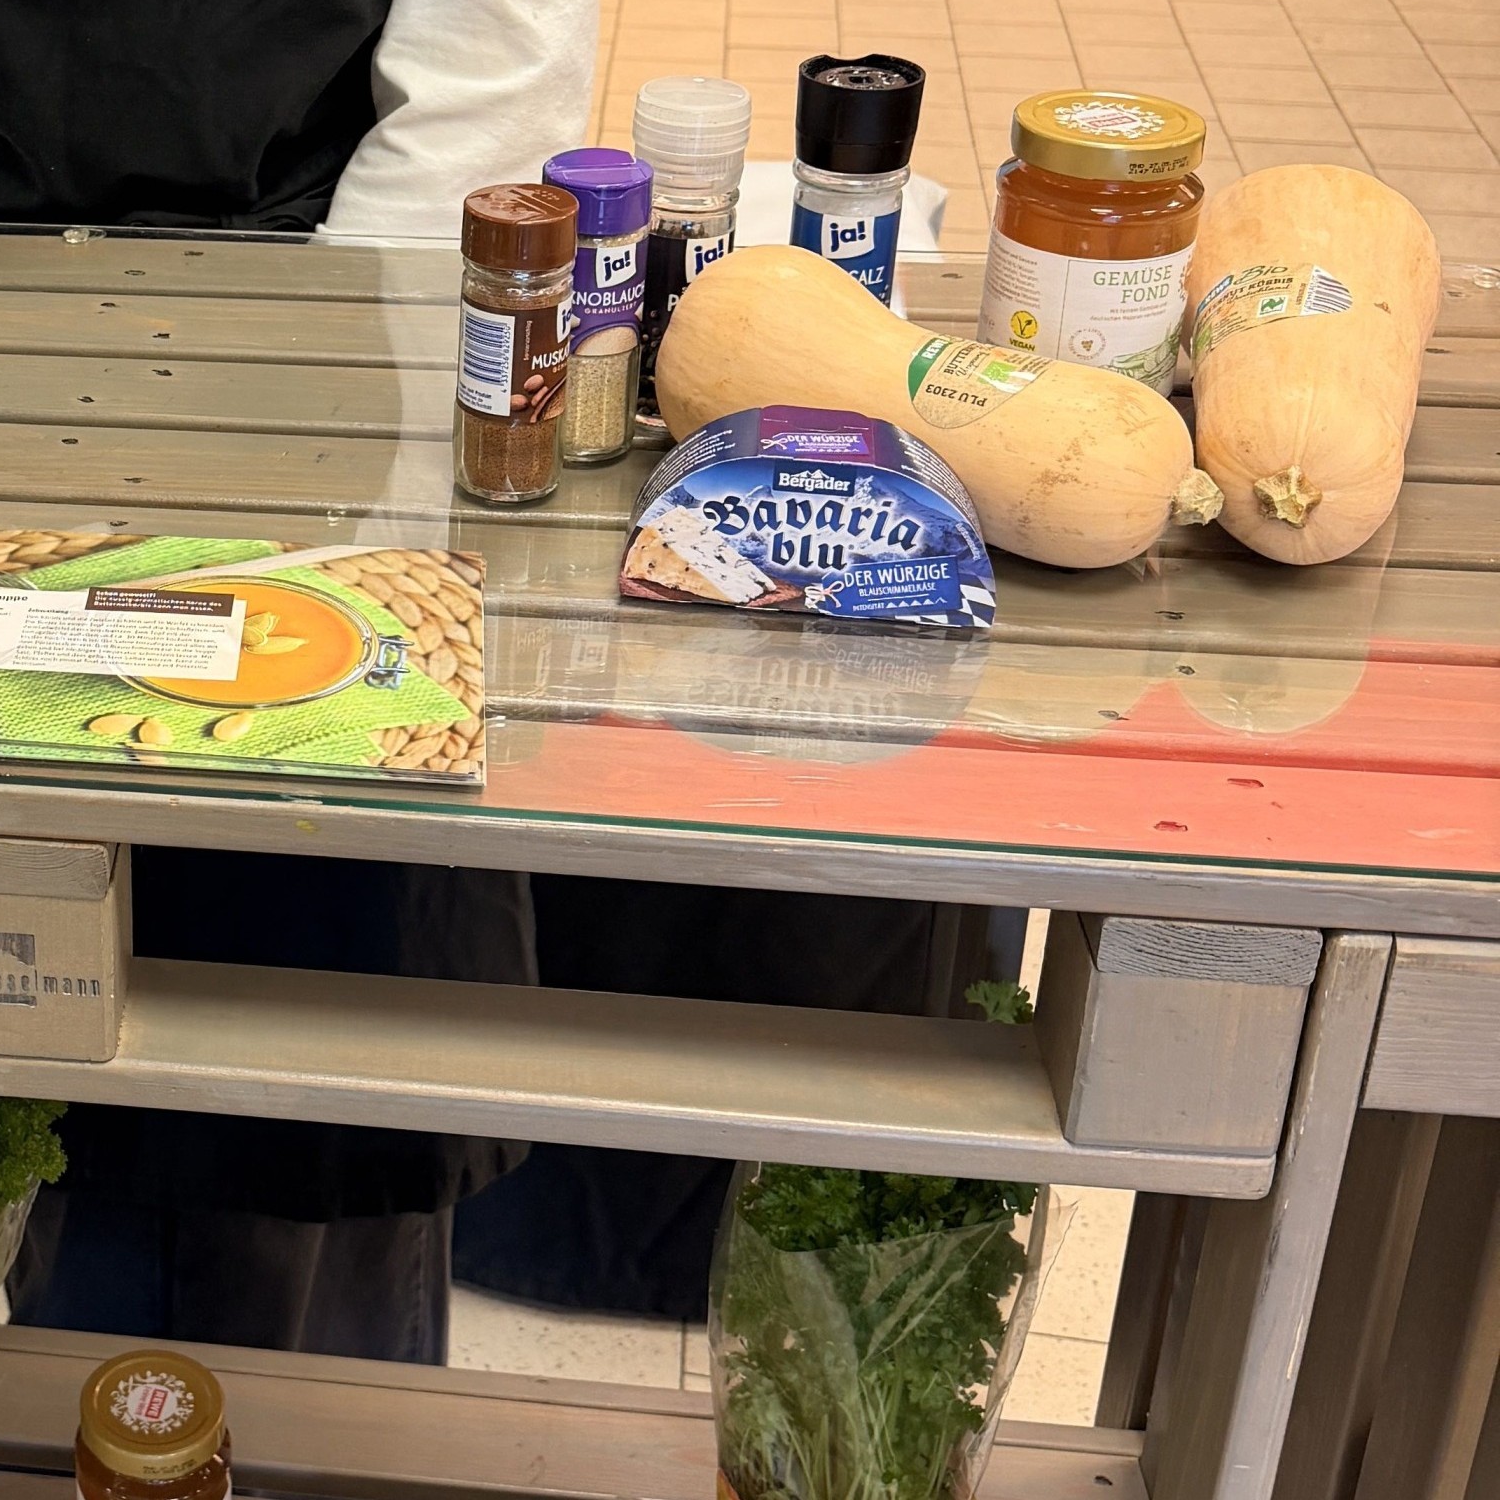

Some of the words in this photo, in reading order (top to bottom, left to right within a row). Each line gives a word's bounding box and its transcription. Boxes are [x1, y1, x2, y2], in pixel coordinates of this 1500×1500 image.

[829, 220, 867, 252] ja!
[603, 250, 631, 282] ja!
[694, 238, 724, 275] ja!
[1093, 264, 1173, 286] GEMÜSE
[1233, 265, 1288, 285] Bio
[1120, 283, 1170, 304] FOND
[531, 340, 571, 370] MUSKA
[1009, 338, 1035, 352] VEGAN
[925, 384, 957, 400] 2303
[958, 393, 988, 407] PLU
[778, 472, 851, 491] Bergader
[703, 495, 921, 551] Bavaria
[771, 532, 847, 570] blu
[844, 570, 874, 588] DER
[877, 563, 950, 585] WÜRZIGE
